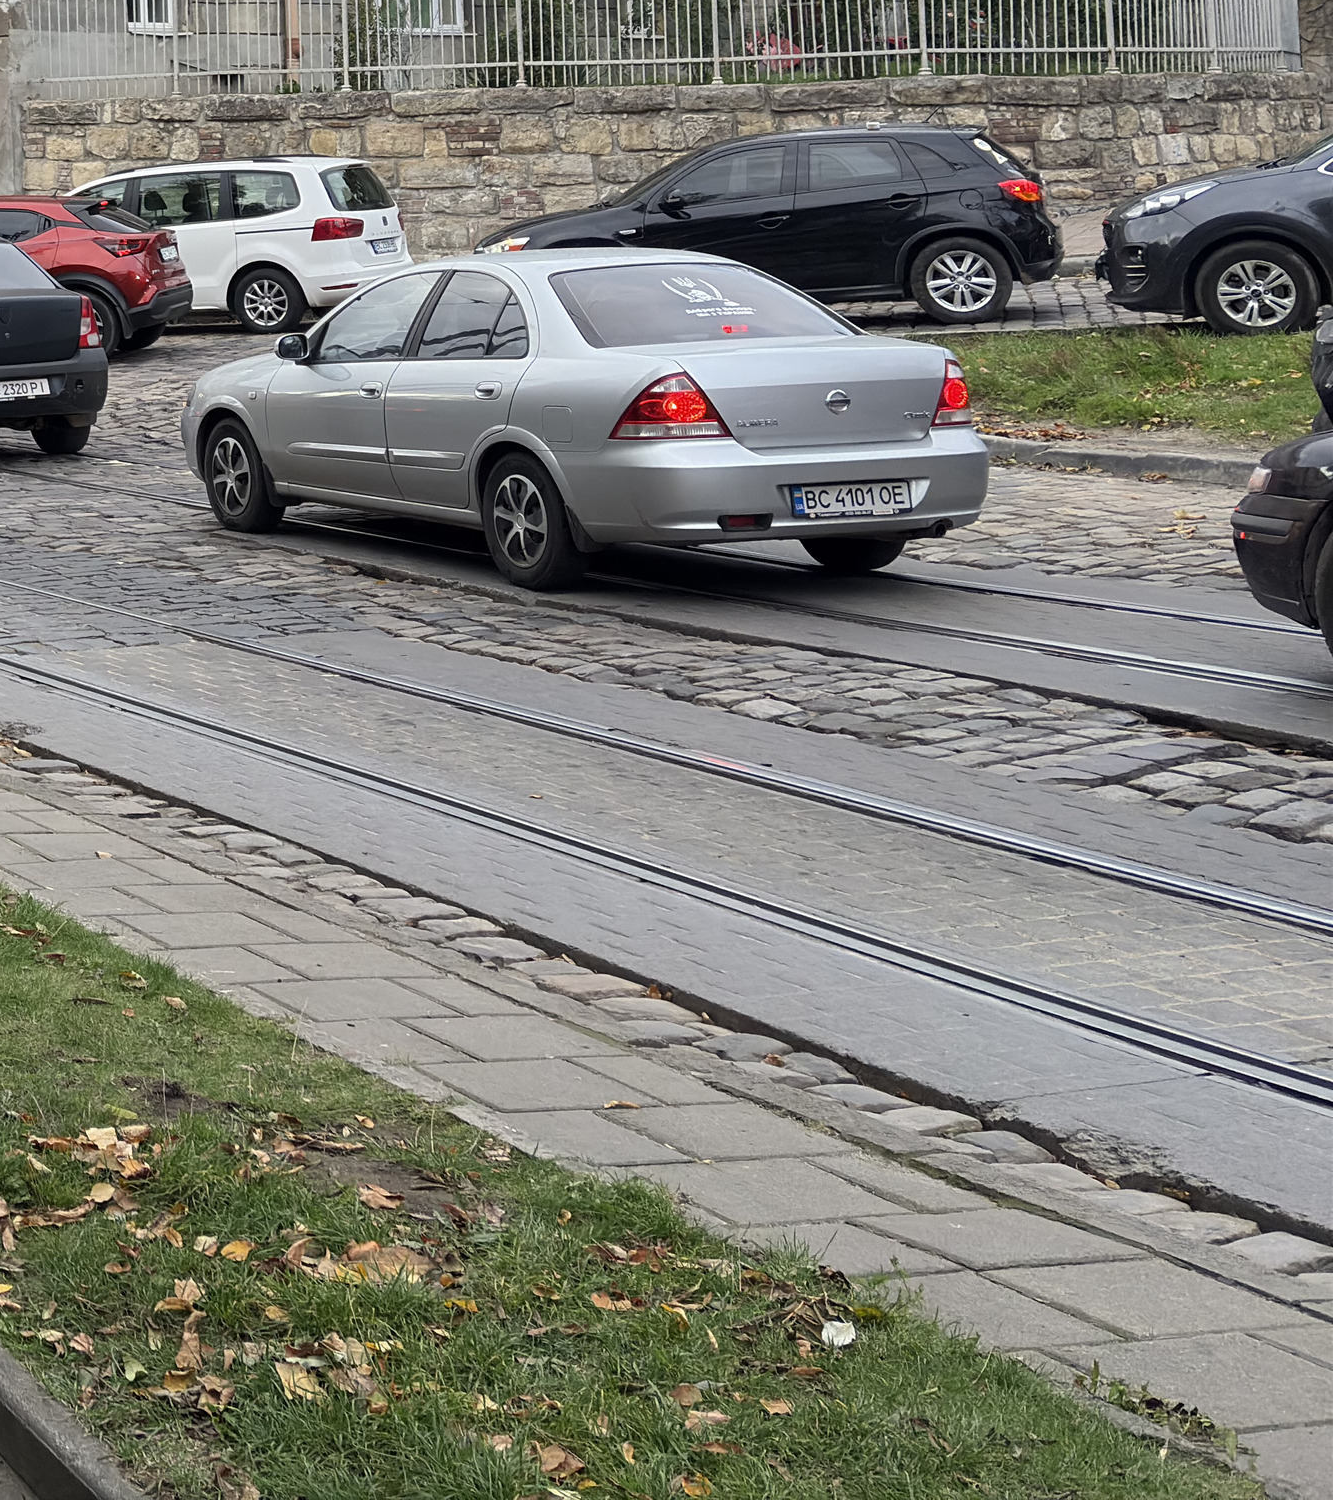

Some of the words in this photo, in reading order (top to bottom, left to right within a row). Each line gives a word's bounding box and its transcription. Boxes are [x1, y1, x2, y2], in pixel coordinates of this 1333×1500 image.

[3, 383, 29, 396] 2320
[30, 382, 45, 394] PI
[735, 418, 779, 428] ALMERA
[804, 490, 831, 510] BC
[835, 487, 875, 507] 4101
[879, 485, 905, 505] OE
